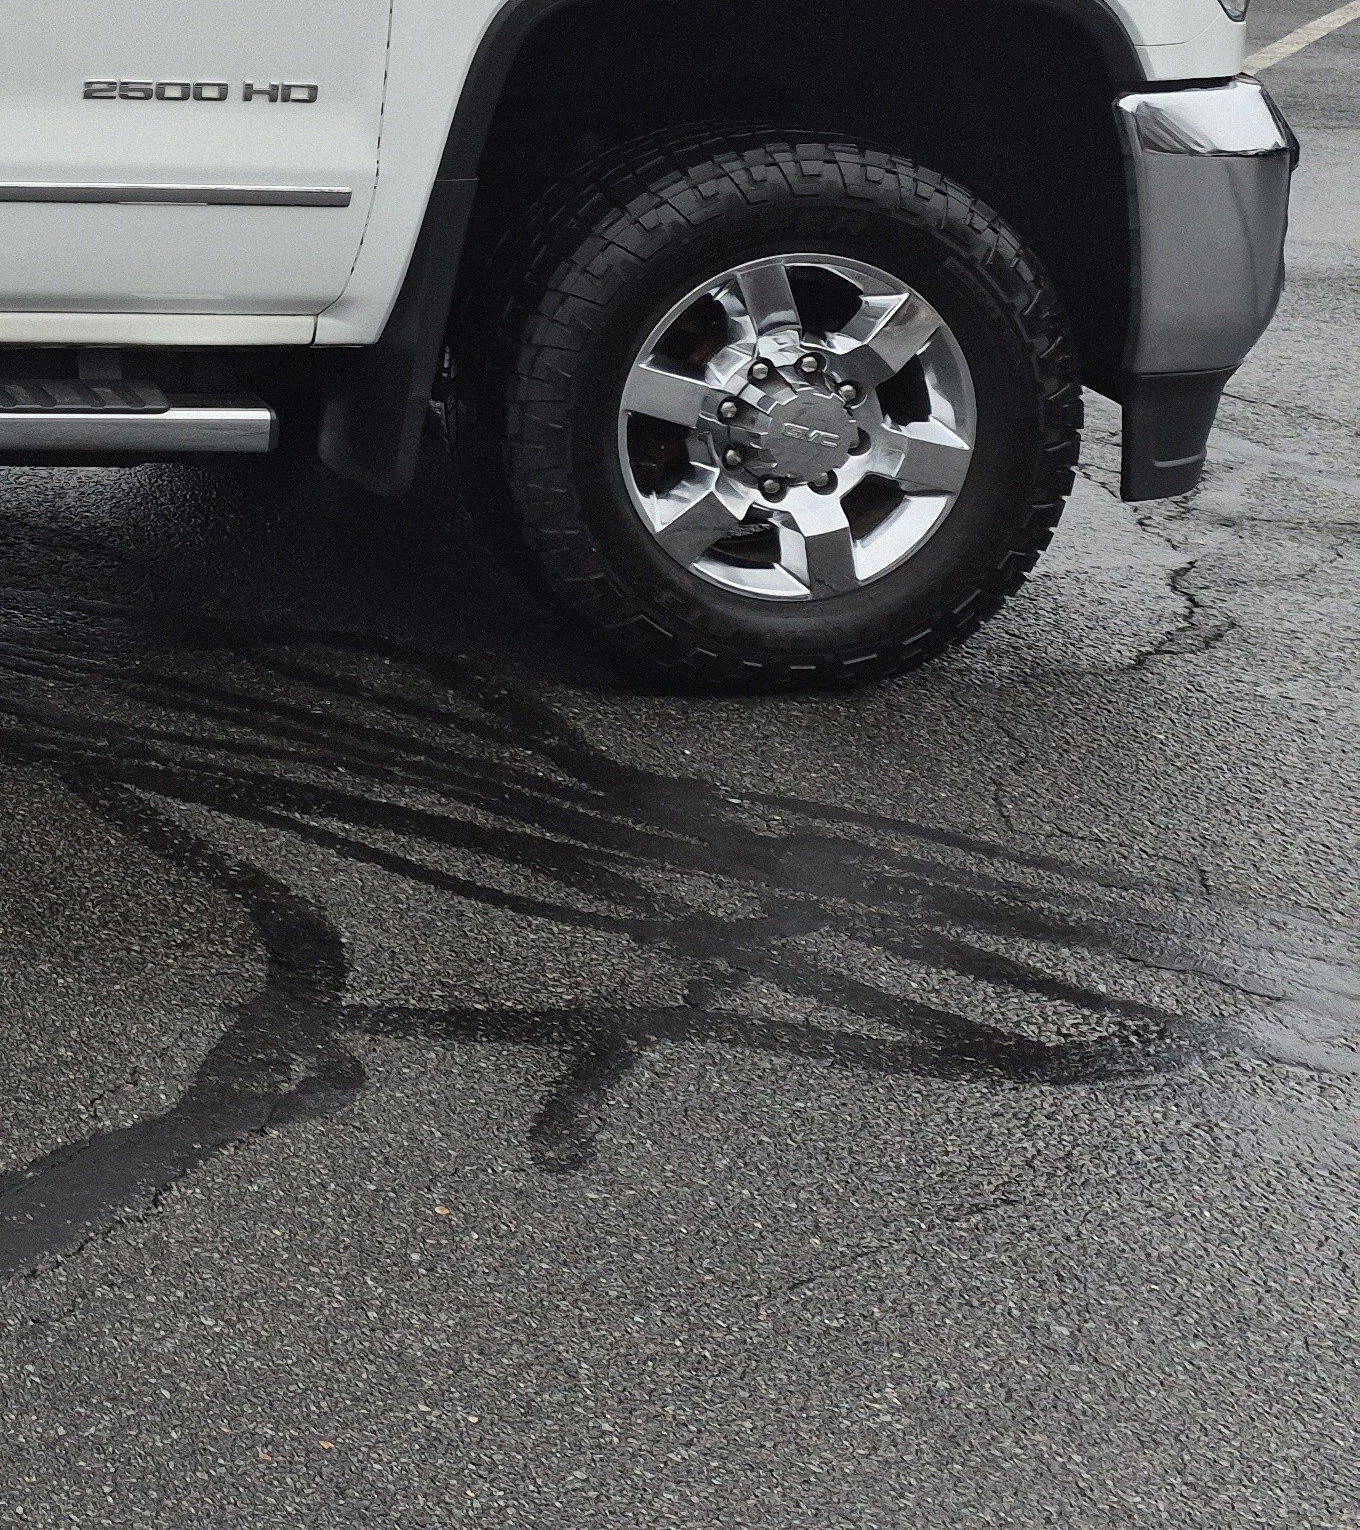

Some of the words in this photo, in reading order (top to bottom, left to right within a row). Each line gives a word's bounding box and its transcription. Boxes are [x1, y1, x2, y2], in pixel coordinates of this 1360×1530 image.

[83, 78, 228, 102] 2500
[242, 80, 319, 103] HD
[782, 422, 840, 448] GMC
